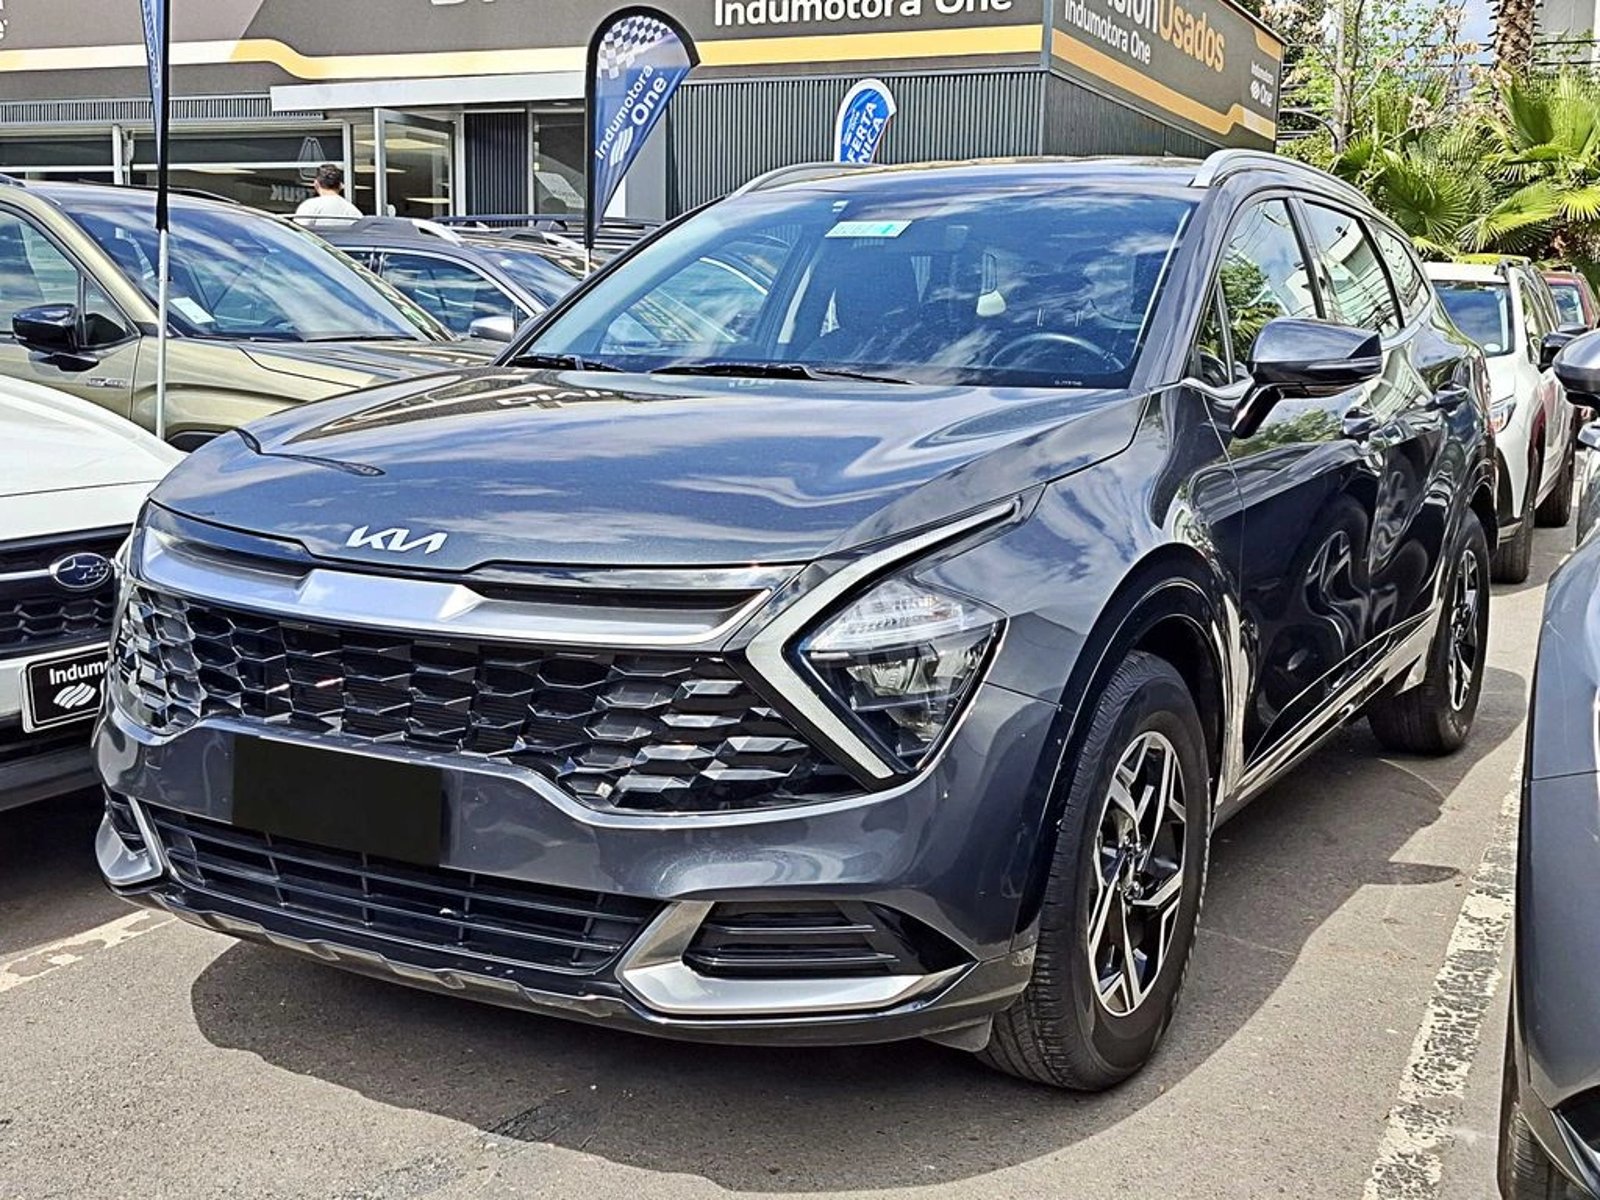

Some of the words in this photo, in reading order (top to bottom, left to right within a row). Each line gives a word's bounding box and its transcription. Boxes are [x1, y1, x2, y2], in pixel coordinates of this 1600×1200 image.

[714, 0, 921, 26] Indumotora
[1065, 0, 1128, 53] Indumotora
[1131, 31, 1151, 65] One
[595, 65, 654, 160] Indumotora
[631, 77, 668, 126] One
[841, 102, 877, 163] FERTA
[858, 118, 884, 163] NICA
[345, 525, 448, 554] KIA
